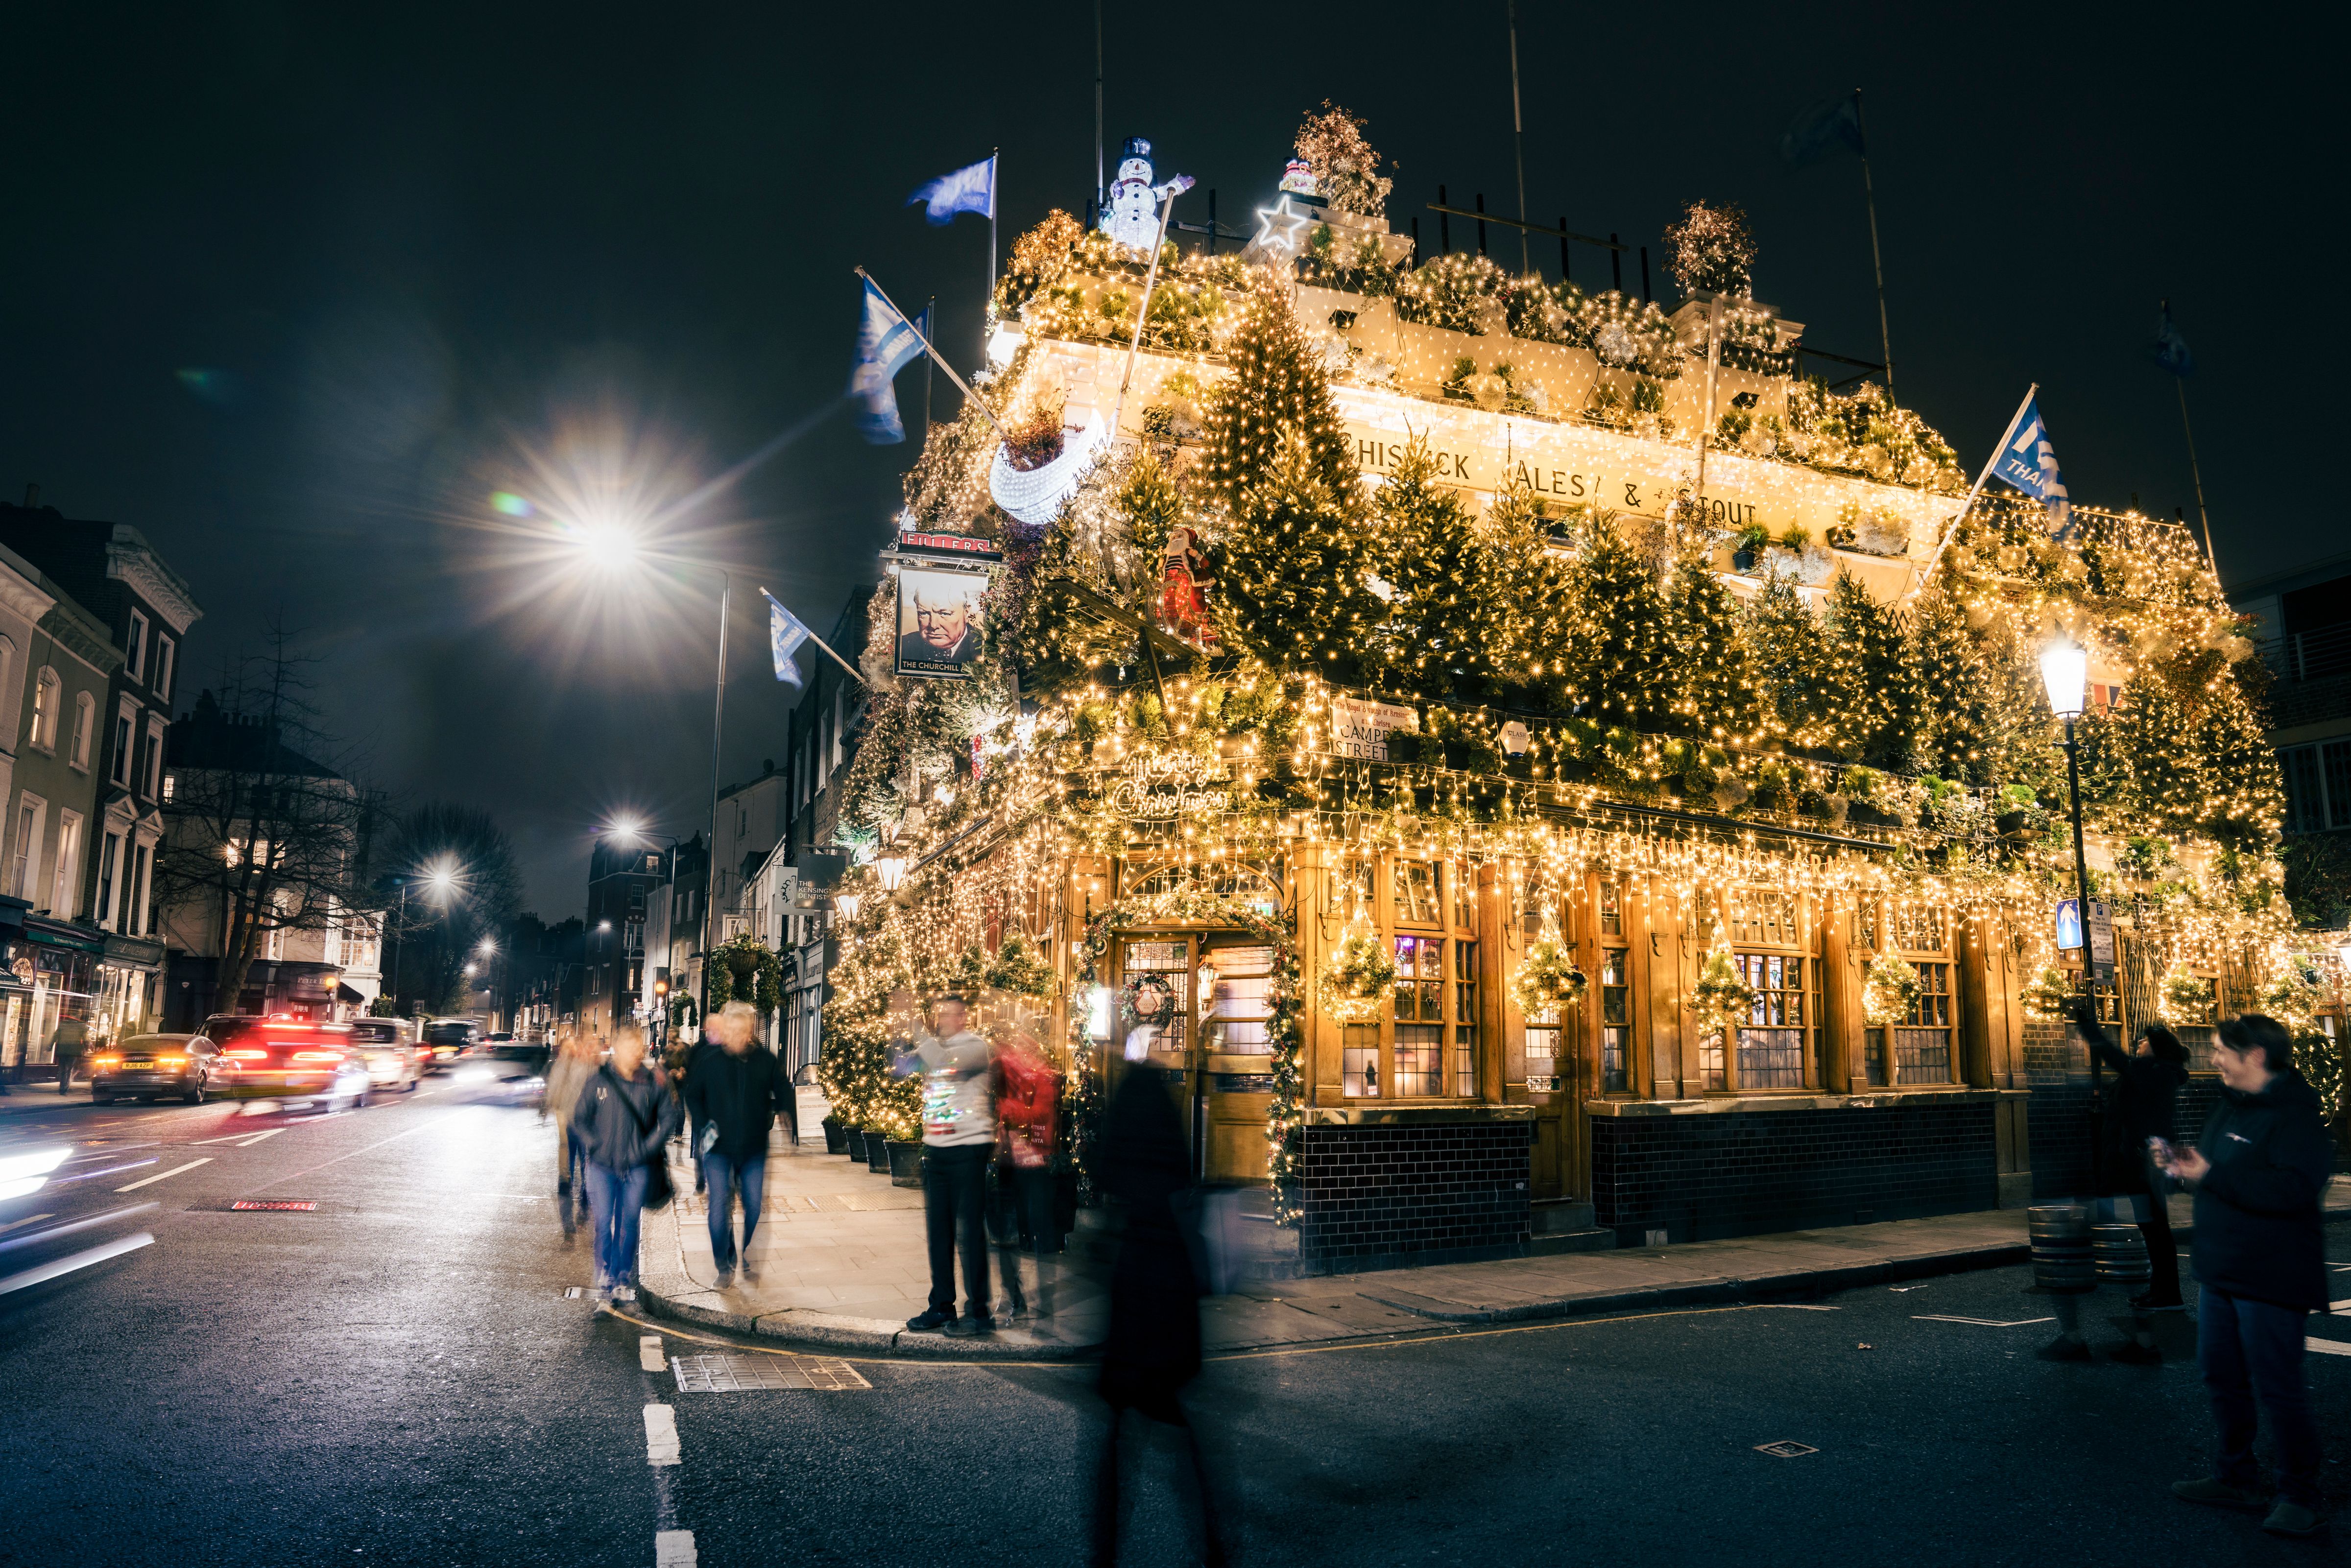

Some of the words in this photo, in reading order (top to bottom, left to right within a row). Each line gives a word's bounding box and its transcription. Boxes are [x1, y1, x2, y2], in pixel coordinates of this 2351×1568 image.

[1340, 432, 1469, 479] HISCK
[1515, 460, 1584, 497] ALES
[1625, 483, 1641, 507] &
[918, 662, 959, 671] CHURCHILL
[1347, 703, 1360, 713] Royal
[1372, 719, 1391, 728] Chelsea
[1336, 741, 1388, 760] STREET
